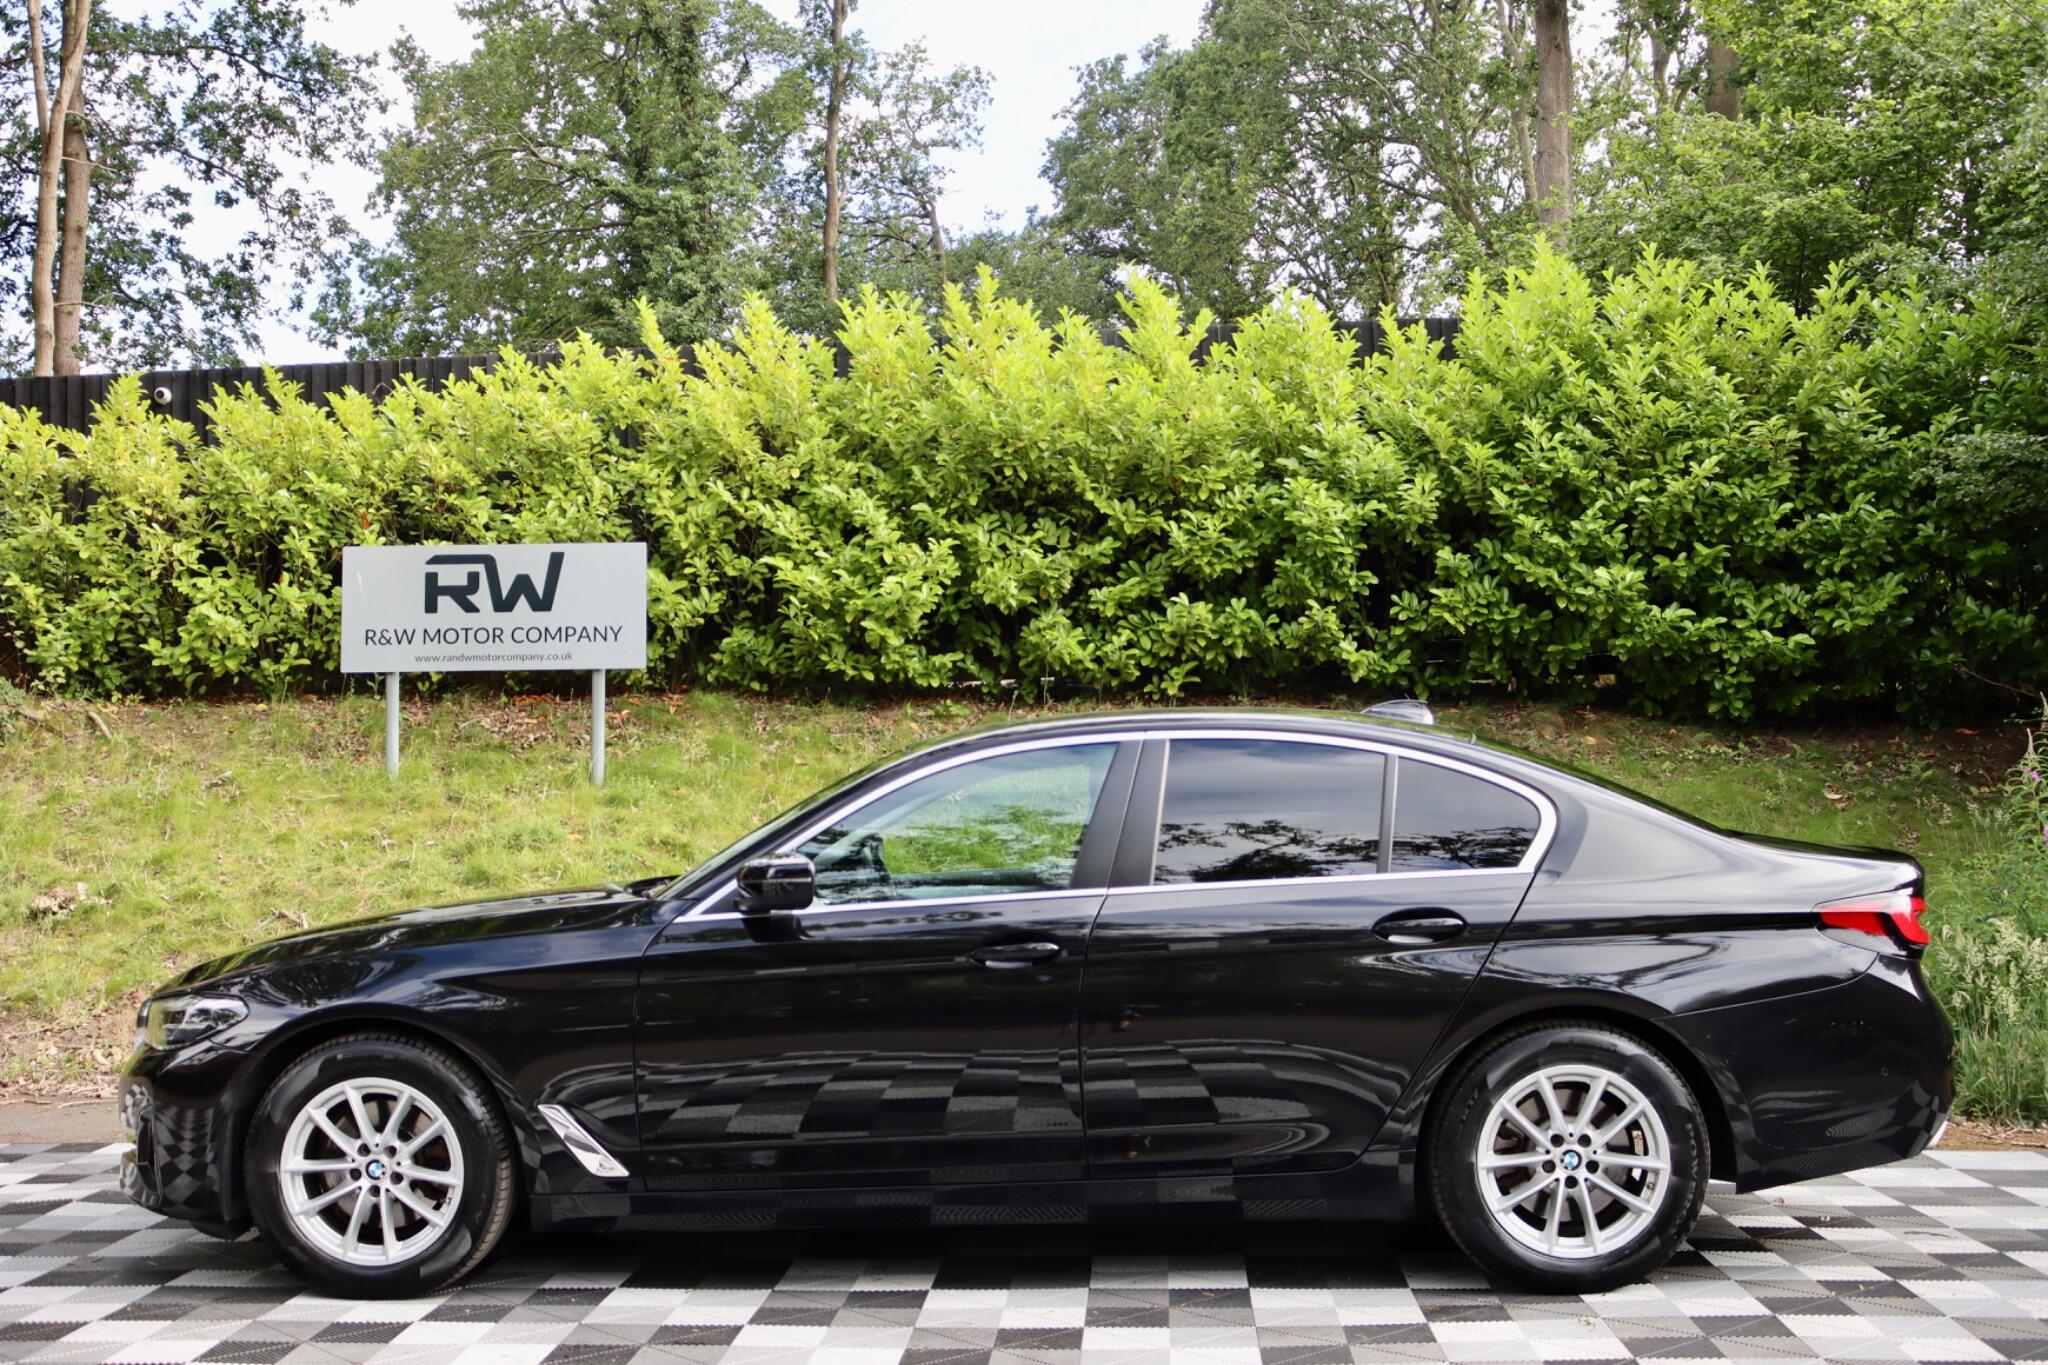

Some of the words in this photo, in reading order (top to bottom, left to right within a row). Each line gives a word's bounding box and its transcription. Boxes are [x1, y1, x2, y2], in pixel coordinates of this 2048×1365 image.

[424, 551, 565, 614] RW
[364, 628, 417, 647] R&W
[422, 627, 505, 646] MOTOR
[510, 625, 623, 645] COMPANY
[414, 651, 574, 664] www.randwmotorcompany.co.uk
